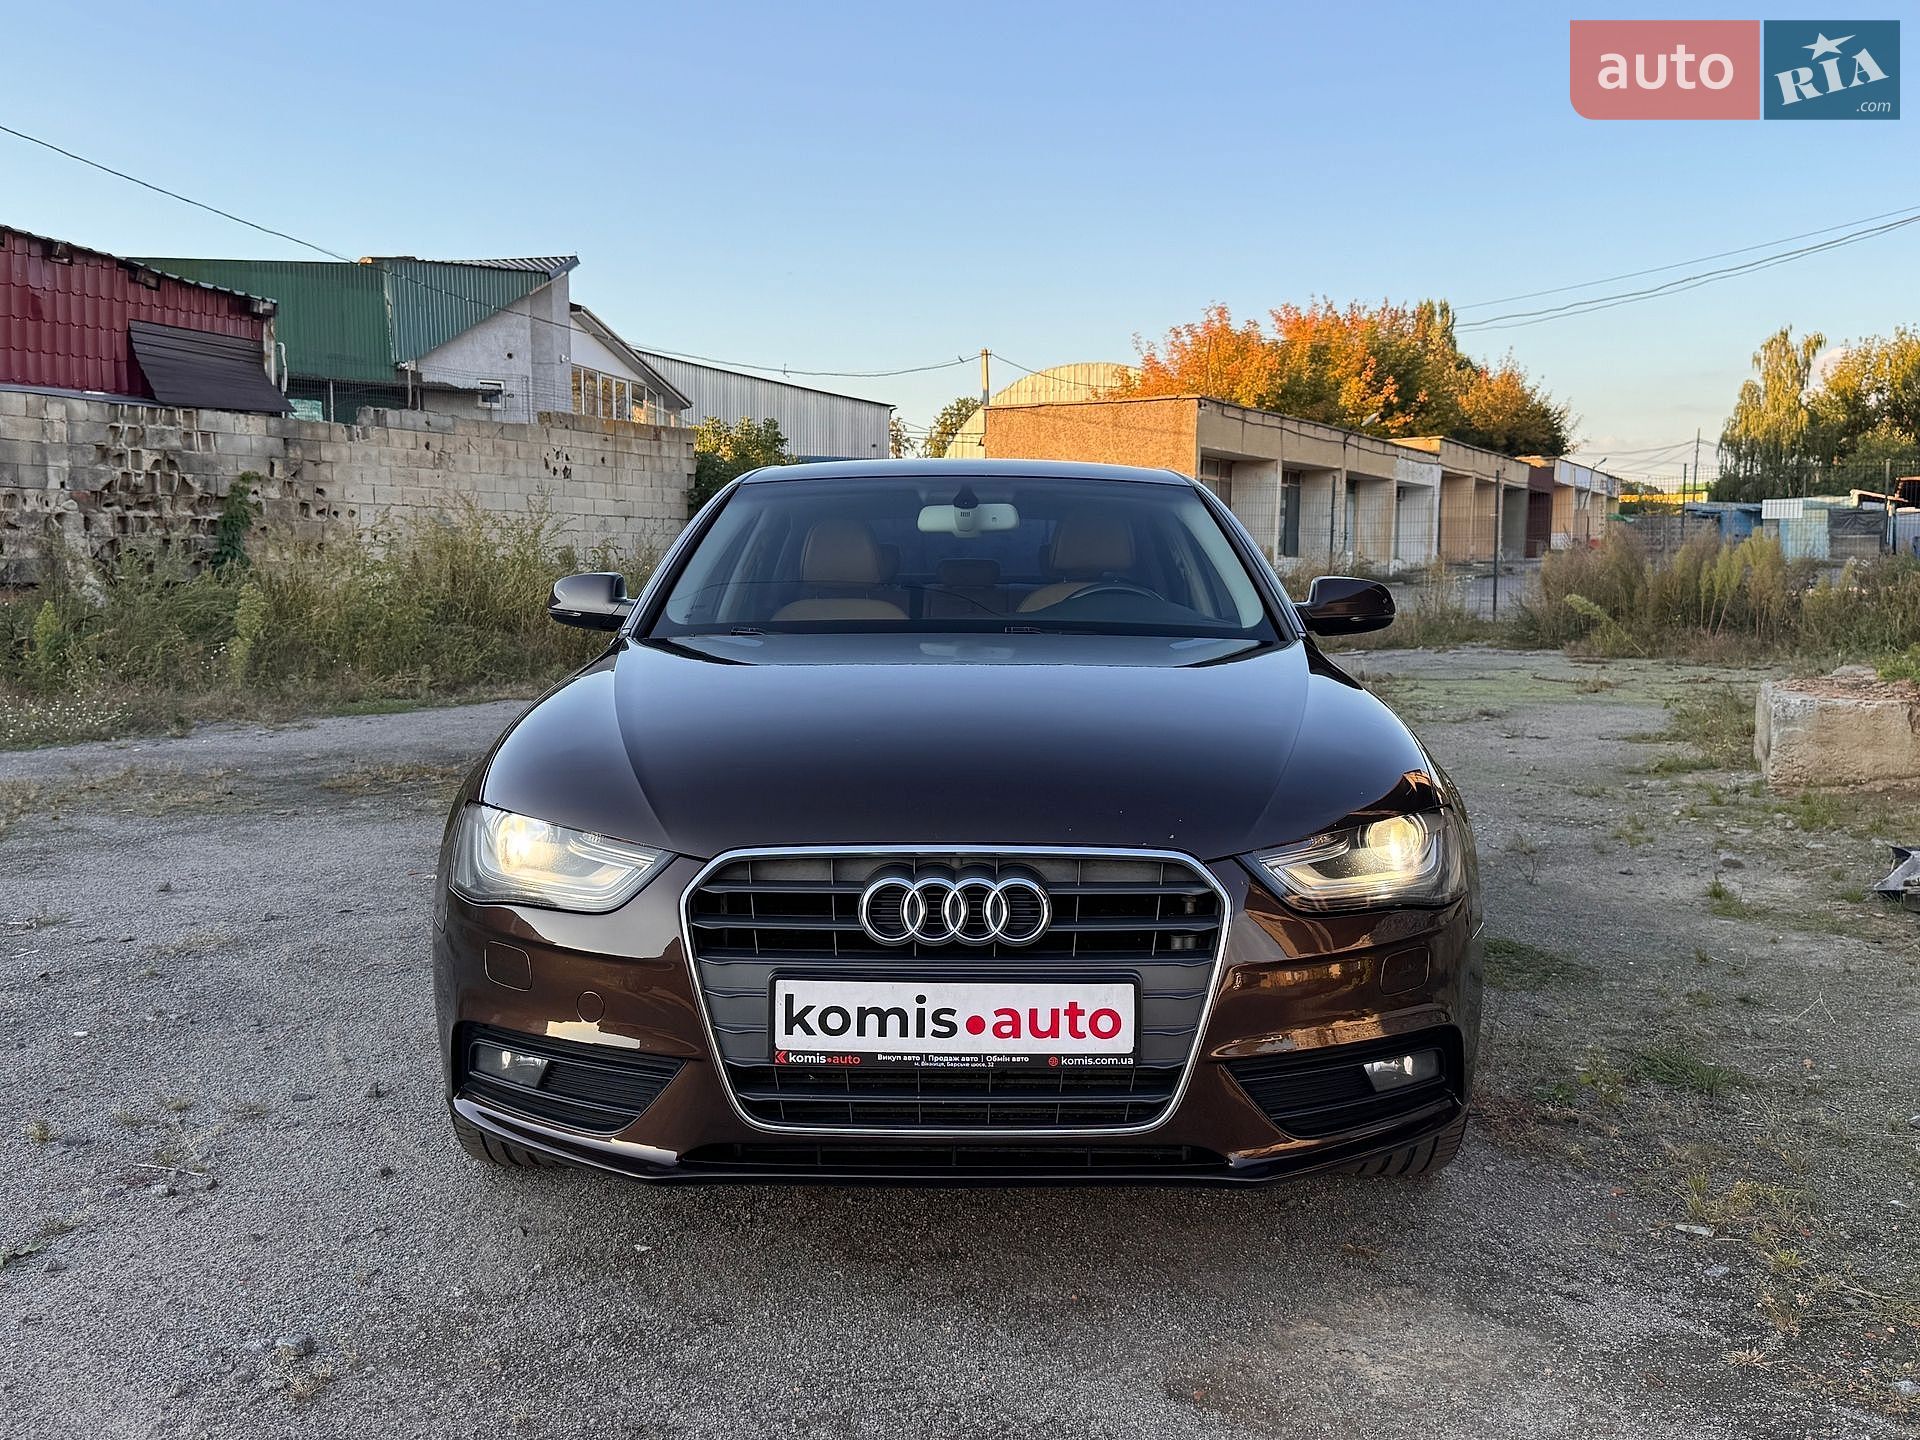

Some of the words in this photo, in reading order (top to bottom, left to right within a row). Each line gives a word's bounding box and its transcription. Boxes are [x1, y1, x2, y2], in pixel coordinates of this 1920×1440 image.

[877, 1053, 902, 1062] Викуп
[928, 1054, 960, 1063] Продаж
[1061, 1056, 1134, 1065] komis.com.ua
